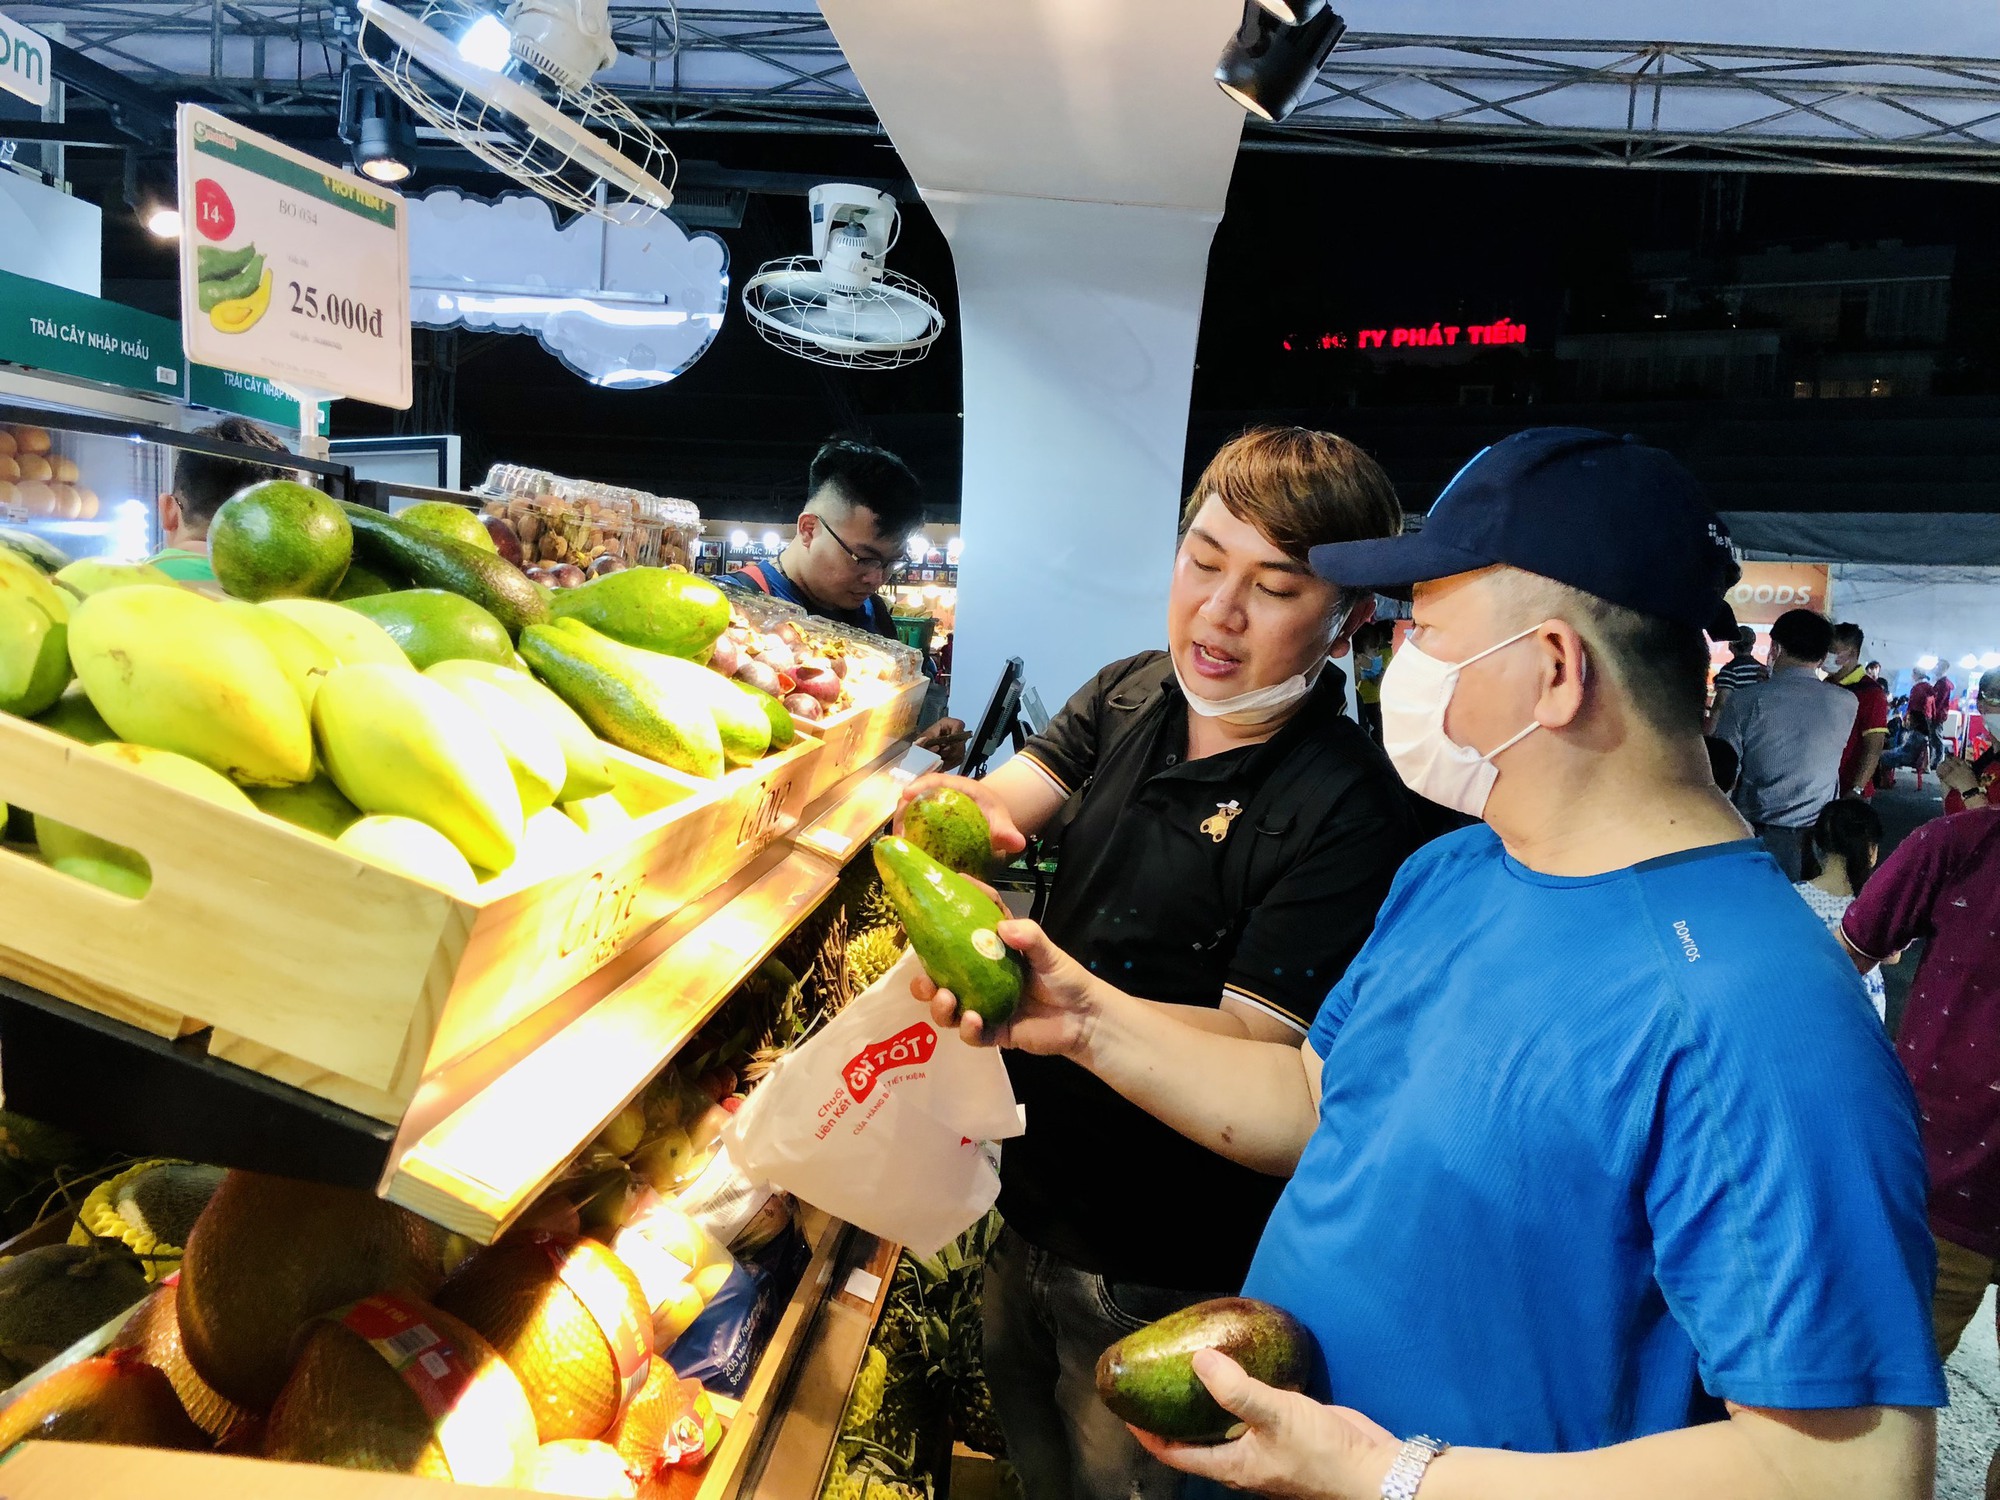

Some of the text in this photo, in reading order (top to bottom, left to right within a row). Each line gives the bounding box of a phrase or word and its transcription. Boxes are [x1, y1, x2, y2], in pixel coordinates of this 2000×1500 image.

[289, 281, 383, 338] 25.000đ
[30, 318, 150, 360] TRÁI CÂY NHẬP KHẨU
[1392, 323, 1460, 348] PHÁT
[1467, 317, 1527, 345] TIẾN
[1733, 583, 1812, 605] OODS
[1672, 920, 1700, 963] DOMYOS
[815, 1099, 852, 1140] Liên Kết
[817, 1088, 845, 1118] Chuỗi
[722, 1358, 739, 1377] 205
